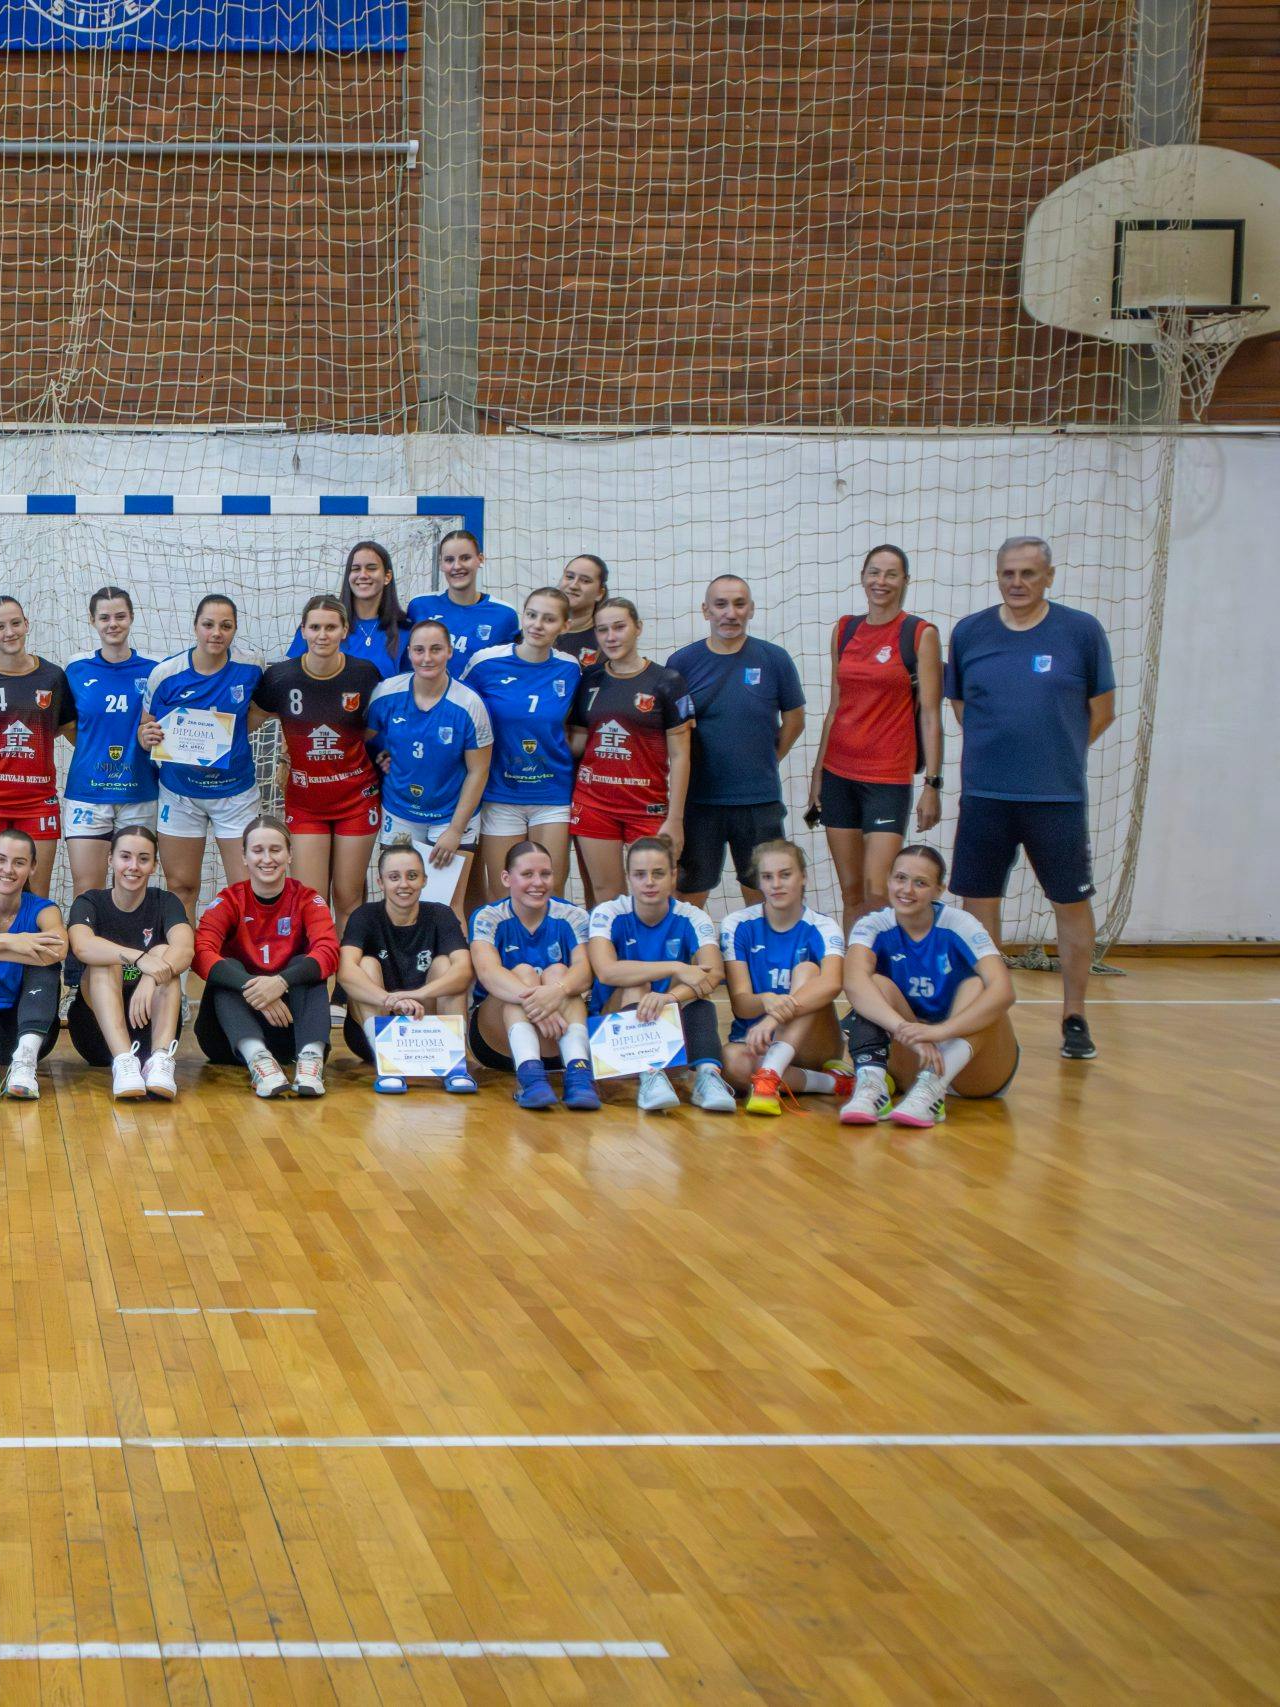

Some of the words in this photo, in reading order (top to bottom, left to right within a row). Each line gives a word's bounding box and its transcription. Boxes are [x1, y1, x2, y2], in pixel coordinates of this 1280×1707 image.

[105, 694, 128, 713] 24
[289, 688, 303, 715] 8
[528, 694, 539, 713] 7
[588, 686, 600, 712] 7
[6, 734, 30, 746] EF
[172, 727, 215, 740] DIPLOMA
[601, 734, 627, 747] EF
[313, 737, 338, 749] EF
[412, 741, 424, 759] 3
[90, 779, 138, 787] bonavia
[72, 807, 95, 825] 24
[160, 804, 170, 823] 4
[39, 815, 57, 832] 14
[384, 815, 393, 833] 3
[259, 944, 270, 964] 1
[768, 968, 791, 989] 14
[909, 976, 935, 998] 25
[396, 1038, 446, 1049] DIPLOMA
[611, 1031, 662, 1047] DIPLOMA
